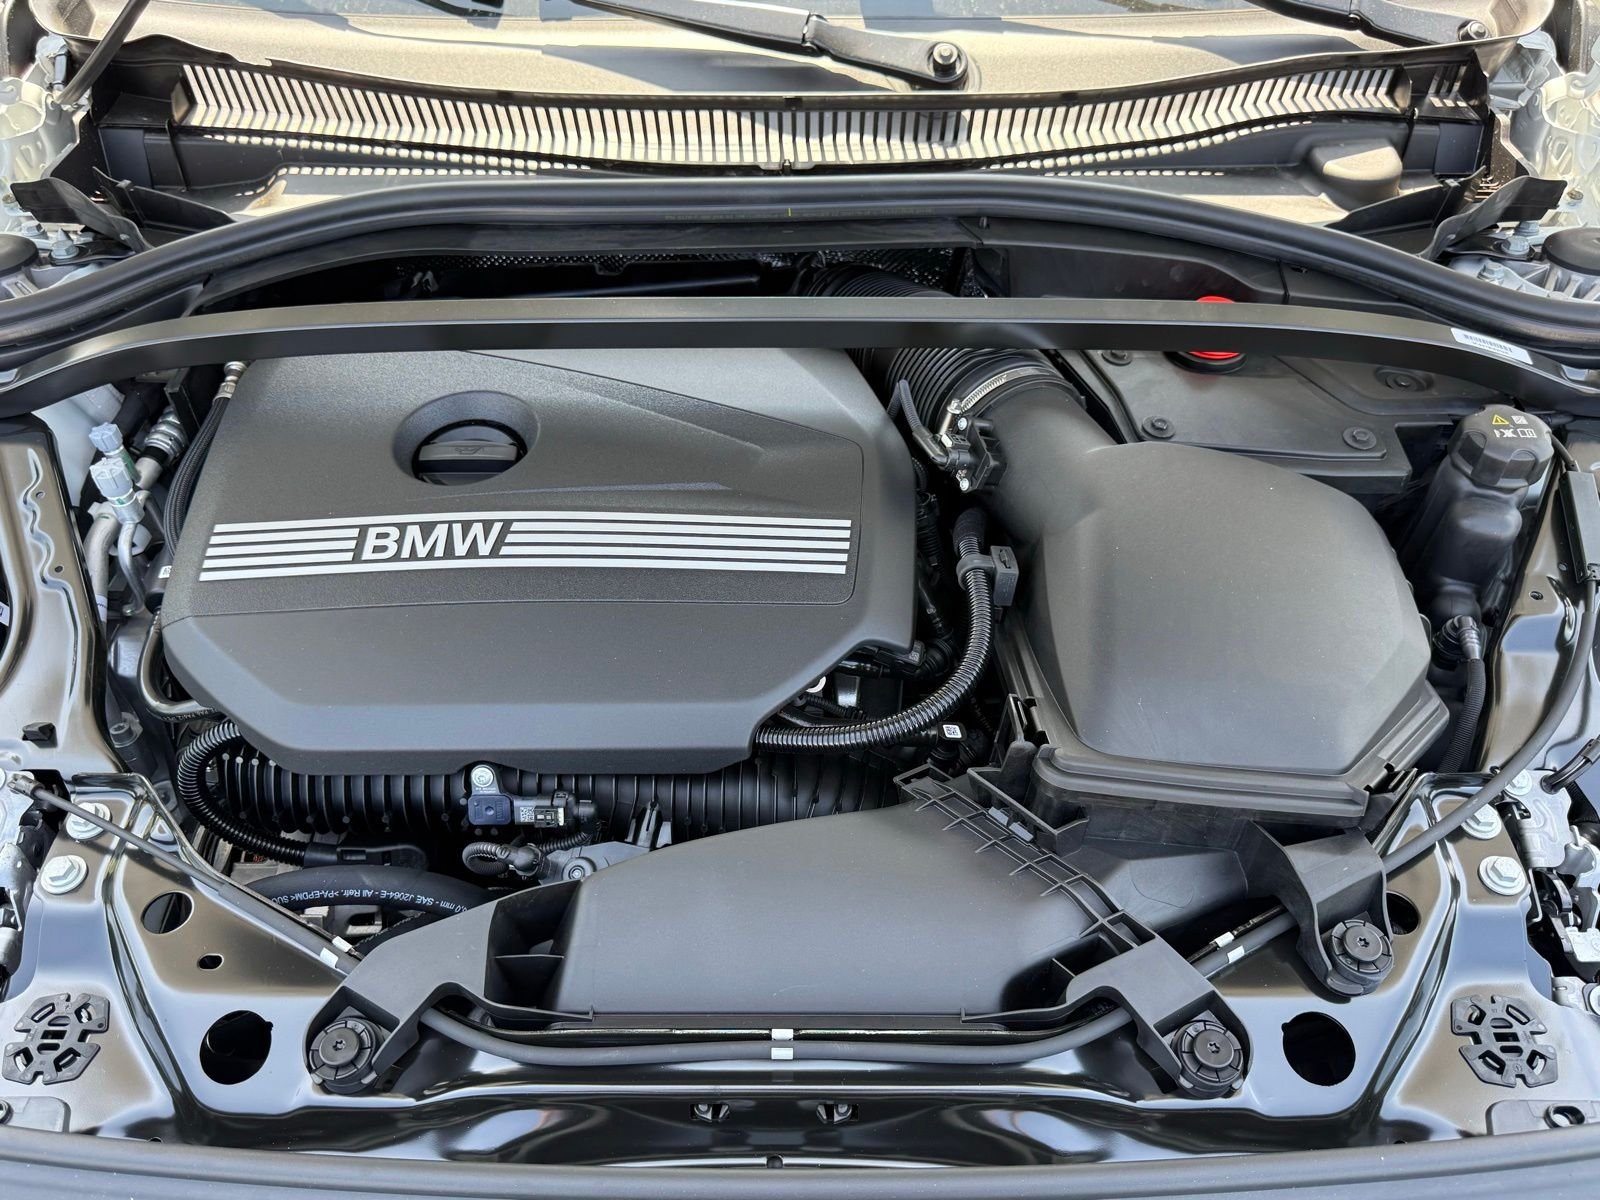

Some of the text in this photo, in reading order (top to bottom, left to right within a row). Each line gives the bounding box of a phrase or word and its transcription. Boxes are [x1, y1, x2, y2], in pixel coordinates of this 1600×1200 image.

[361, 521, 504, 561] BMW
[341, 889, 360, 898] Refr.
[362, 889, 374, 897] All
[380, 890, 414, 902] J2064-E
[415, 895, 435, 906] SAE
[440, 900, 456, 910] mm
